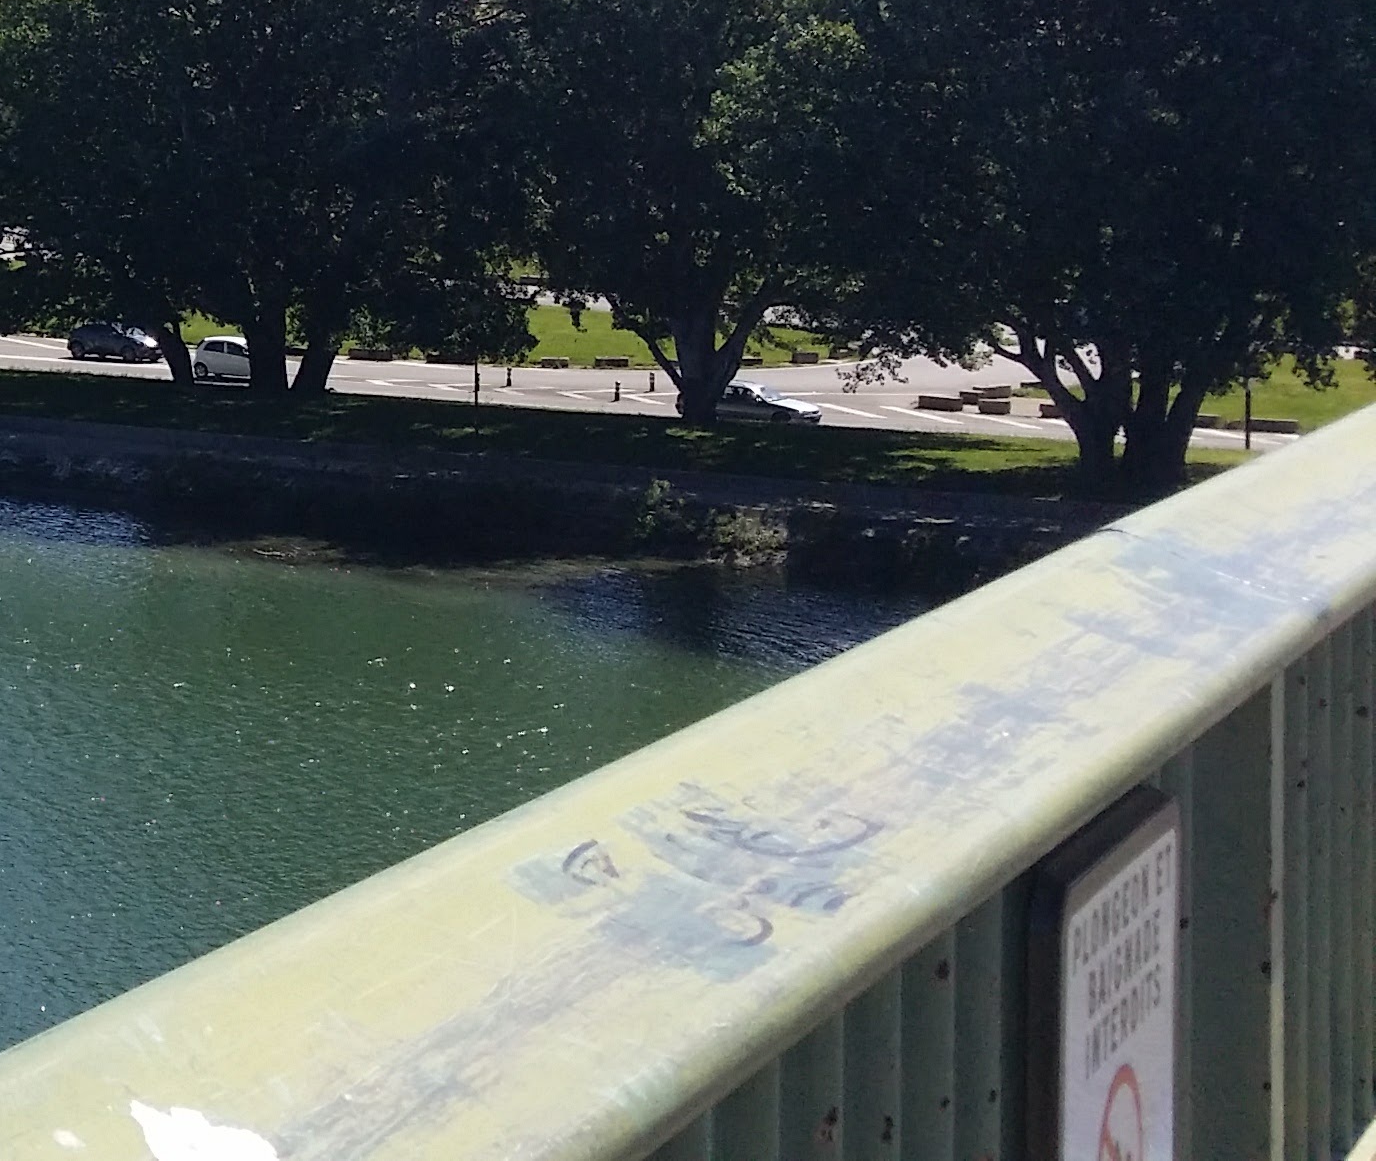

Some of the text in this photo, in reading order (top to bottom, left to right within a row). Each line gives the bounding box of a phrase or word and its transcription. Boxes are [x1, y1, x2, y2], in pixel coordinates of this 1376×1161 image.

[1072, 843, 1172, 977] PLONGEON ET
[1087, 908, 1160, 1019] BAIGNADE
[1085, 962, 1161, 1081] INTERDITS
